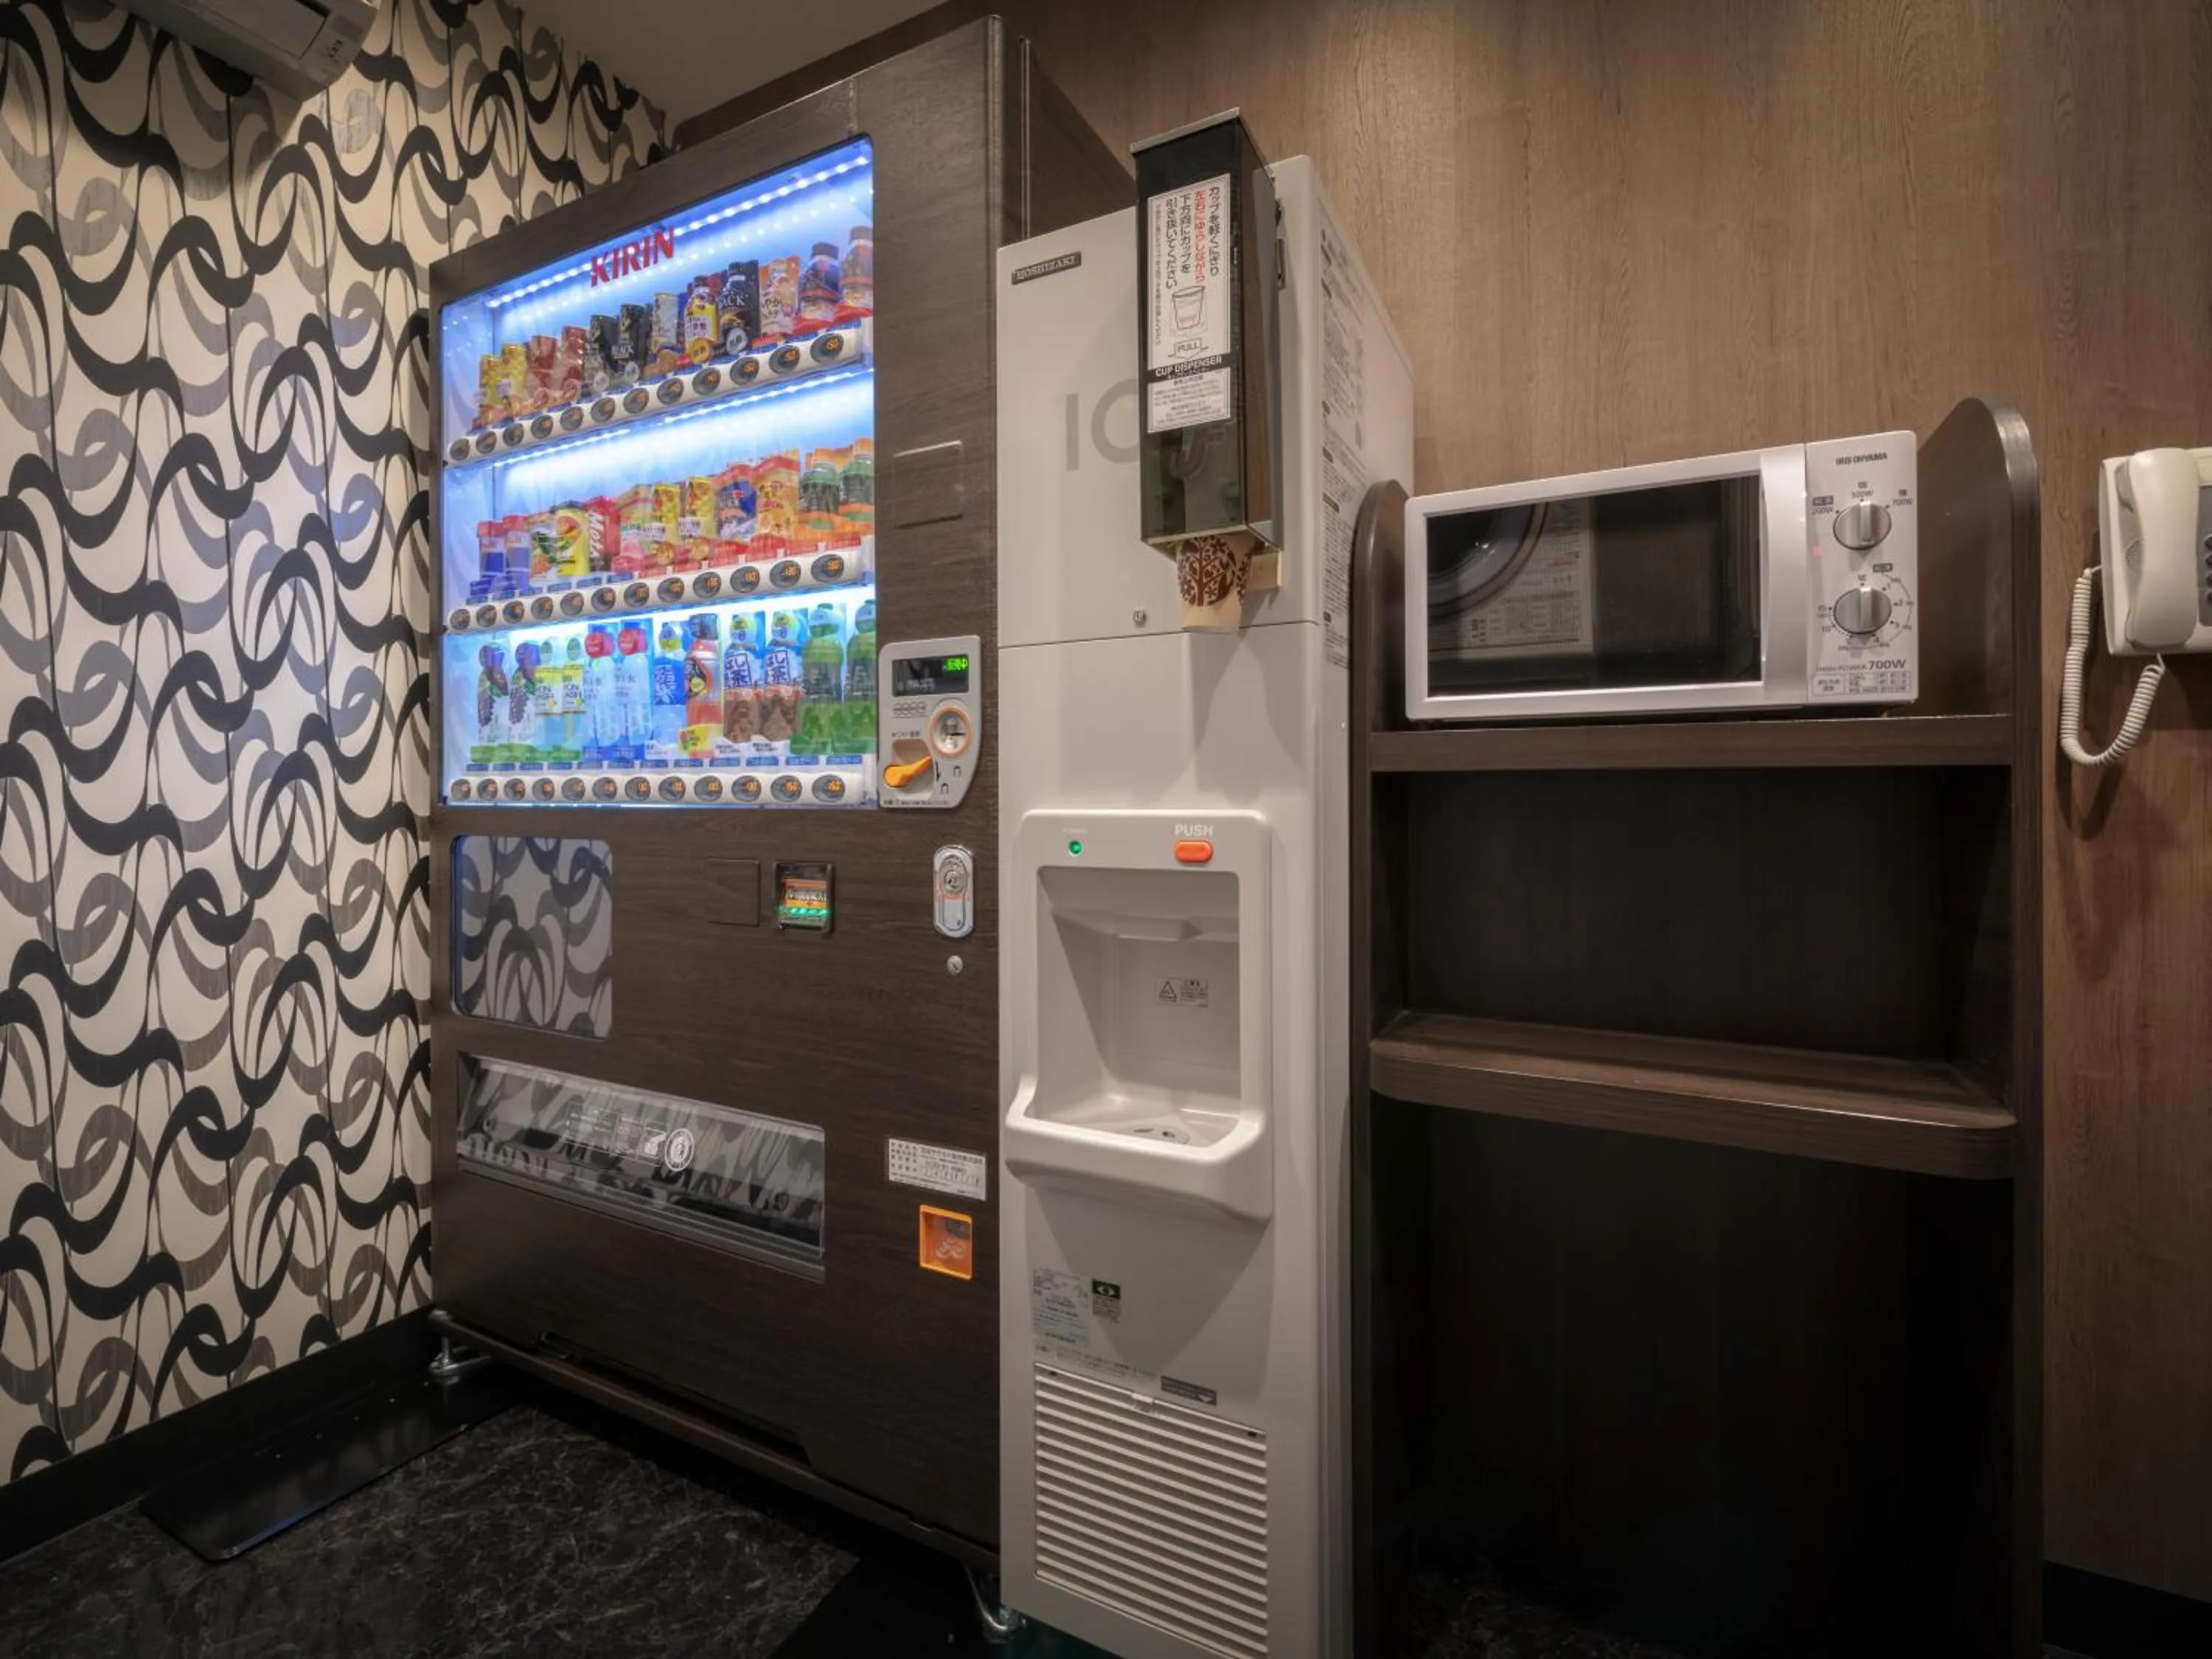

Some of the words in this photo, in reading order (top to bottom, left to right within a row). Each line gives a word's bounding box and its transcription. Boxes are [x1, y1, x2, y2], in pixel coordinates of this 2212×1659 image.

[590, 226, 675, 287] KIRIN
[1017, 256, 1074, 279] HOSHIZAKI
[1178, 341, 1200, 352] PULL
[1155, 365, 1173, 377] CUP
[1175, 355, 1222, 372] DISPENSER
[1835, 456, 1852, 465] IRIS
[1853, 452, 1888, 463] OHYAMA
[1868, 658, 1906, 670] 700W
[1175, 824, 1214, 837] PUSH
